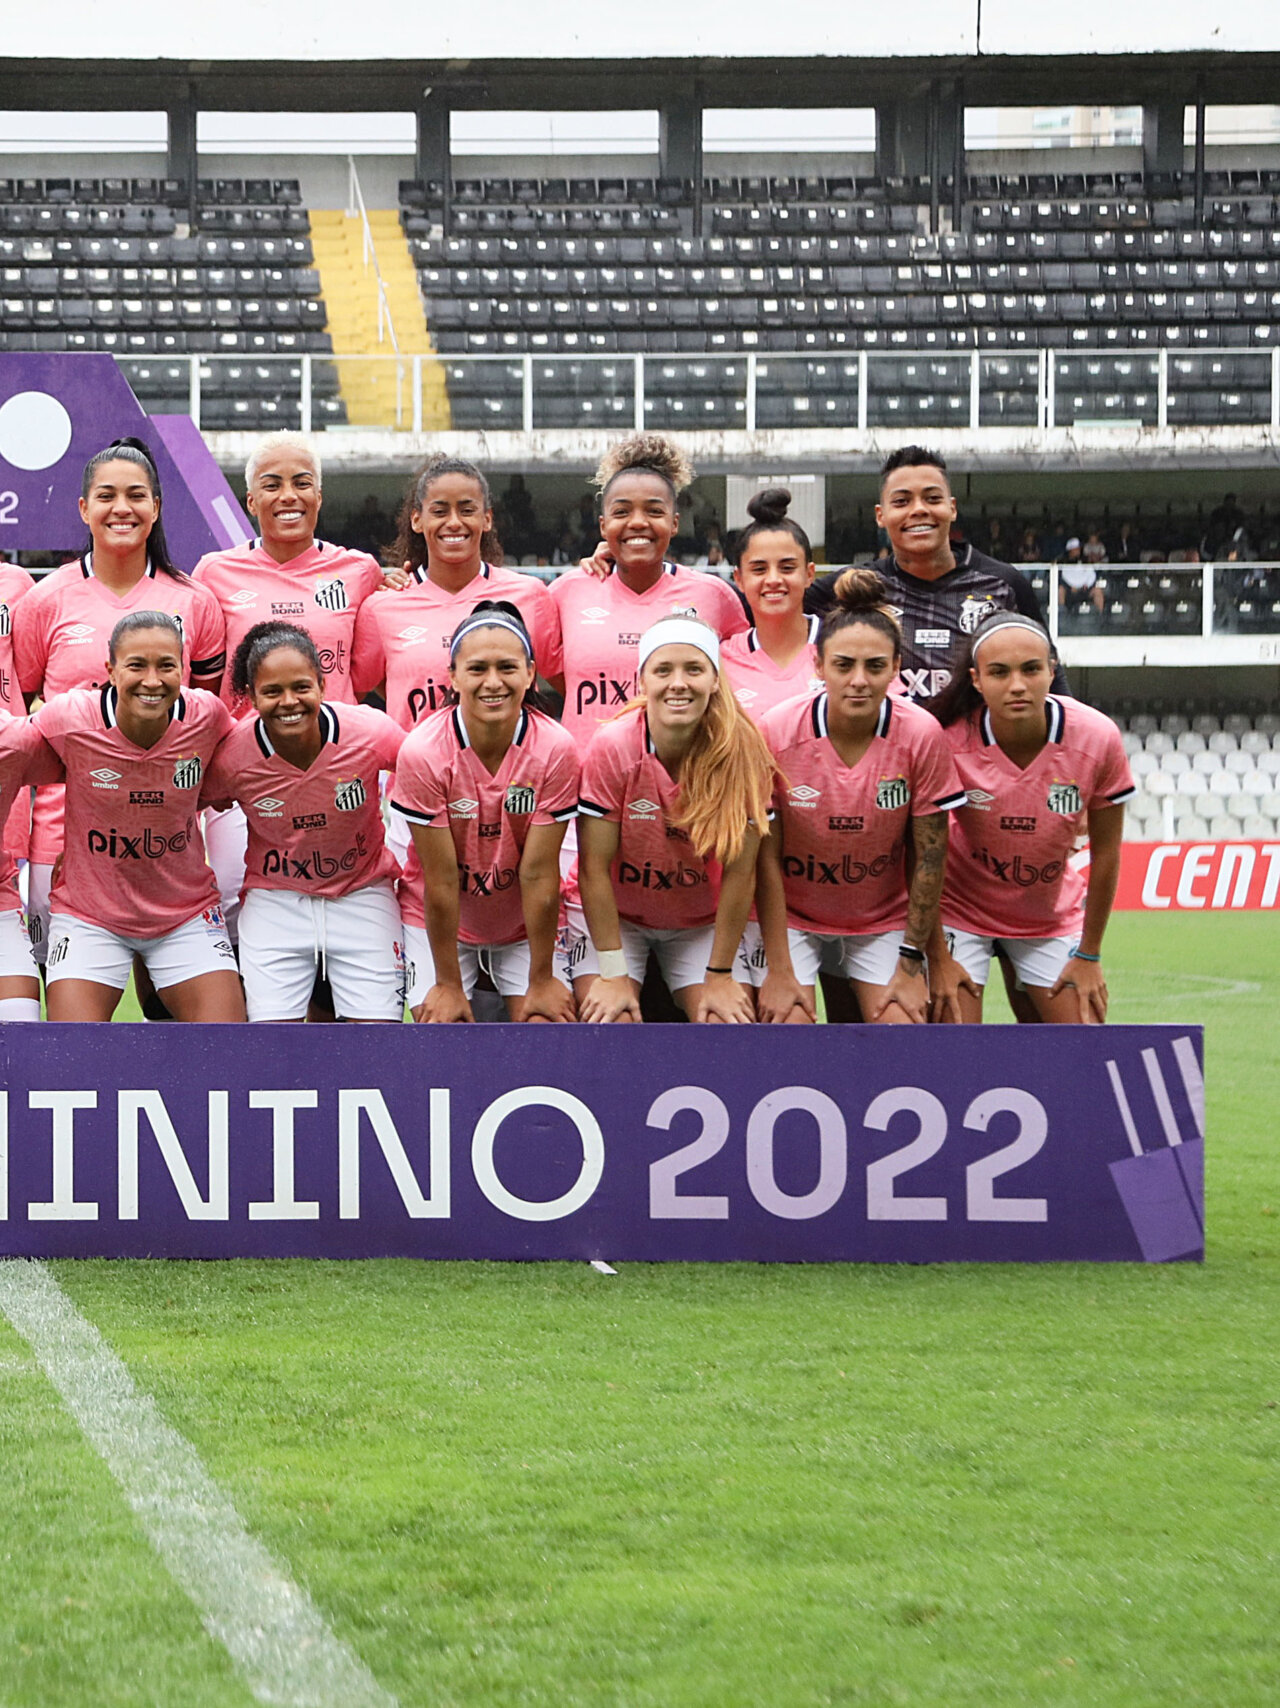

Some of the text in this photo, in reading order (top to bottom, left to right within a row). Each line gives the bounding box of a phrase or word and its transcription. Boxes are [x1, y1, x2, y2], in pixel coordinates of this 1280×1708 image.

[408, 678, 454, 723] pix
[577, 672, 629, 715] pix
[92, 782, 119, 790] umbro
[129, 791, 164, 799] TEK
[88, 817, 193, 859] pixbet
[293, 820, 327, 830] BOND
[262, 832, 367, 880] pixbet
[783, 854, 892, 885] pixbe
[458, 863, 515, 896] ixb
[619, 861, 708, 891] pixb
[647, 1085, 1049, 1222] 2022
